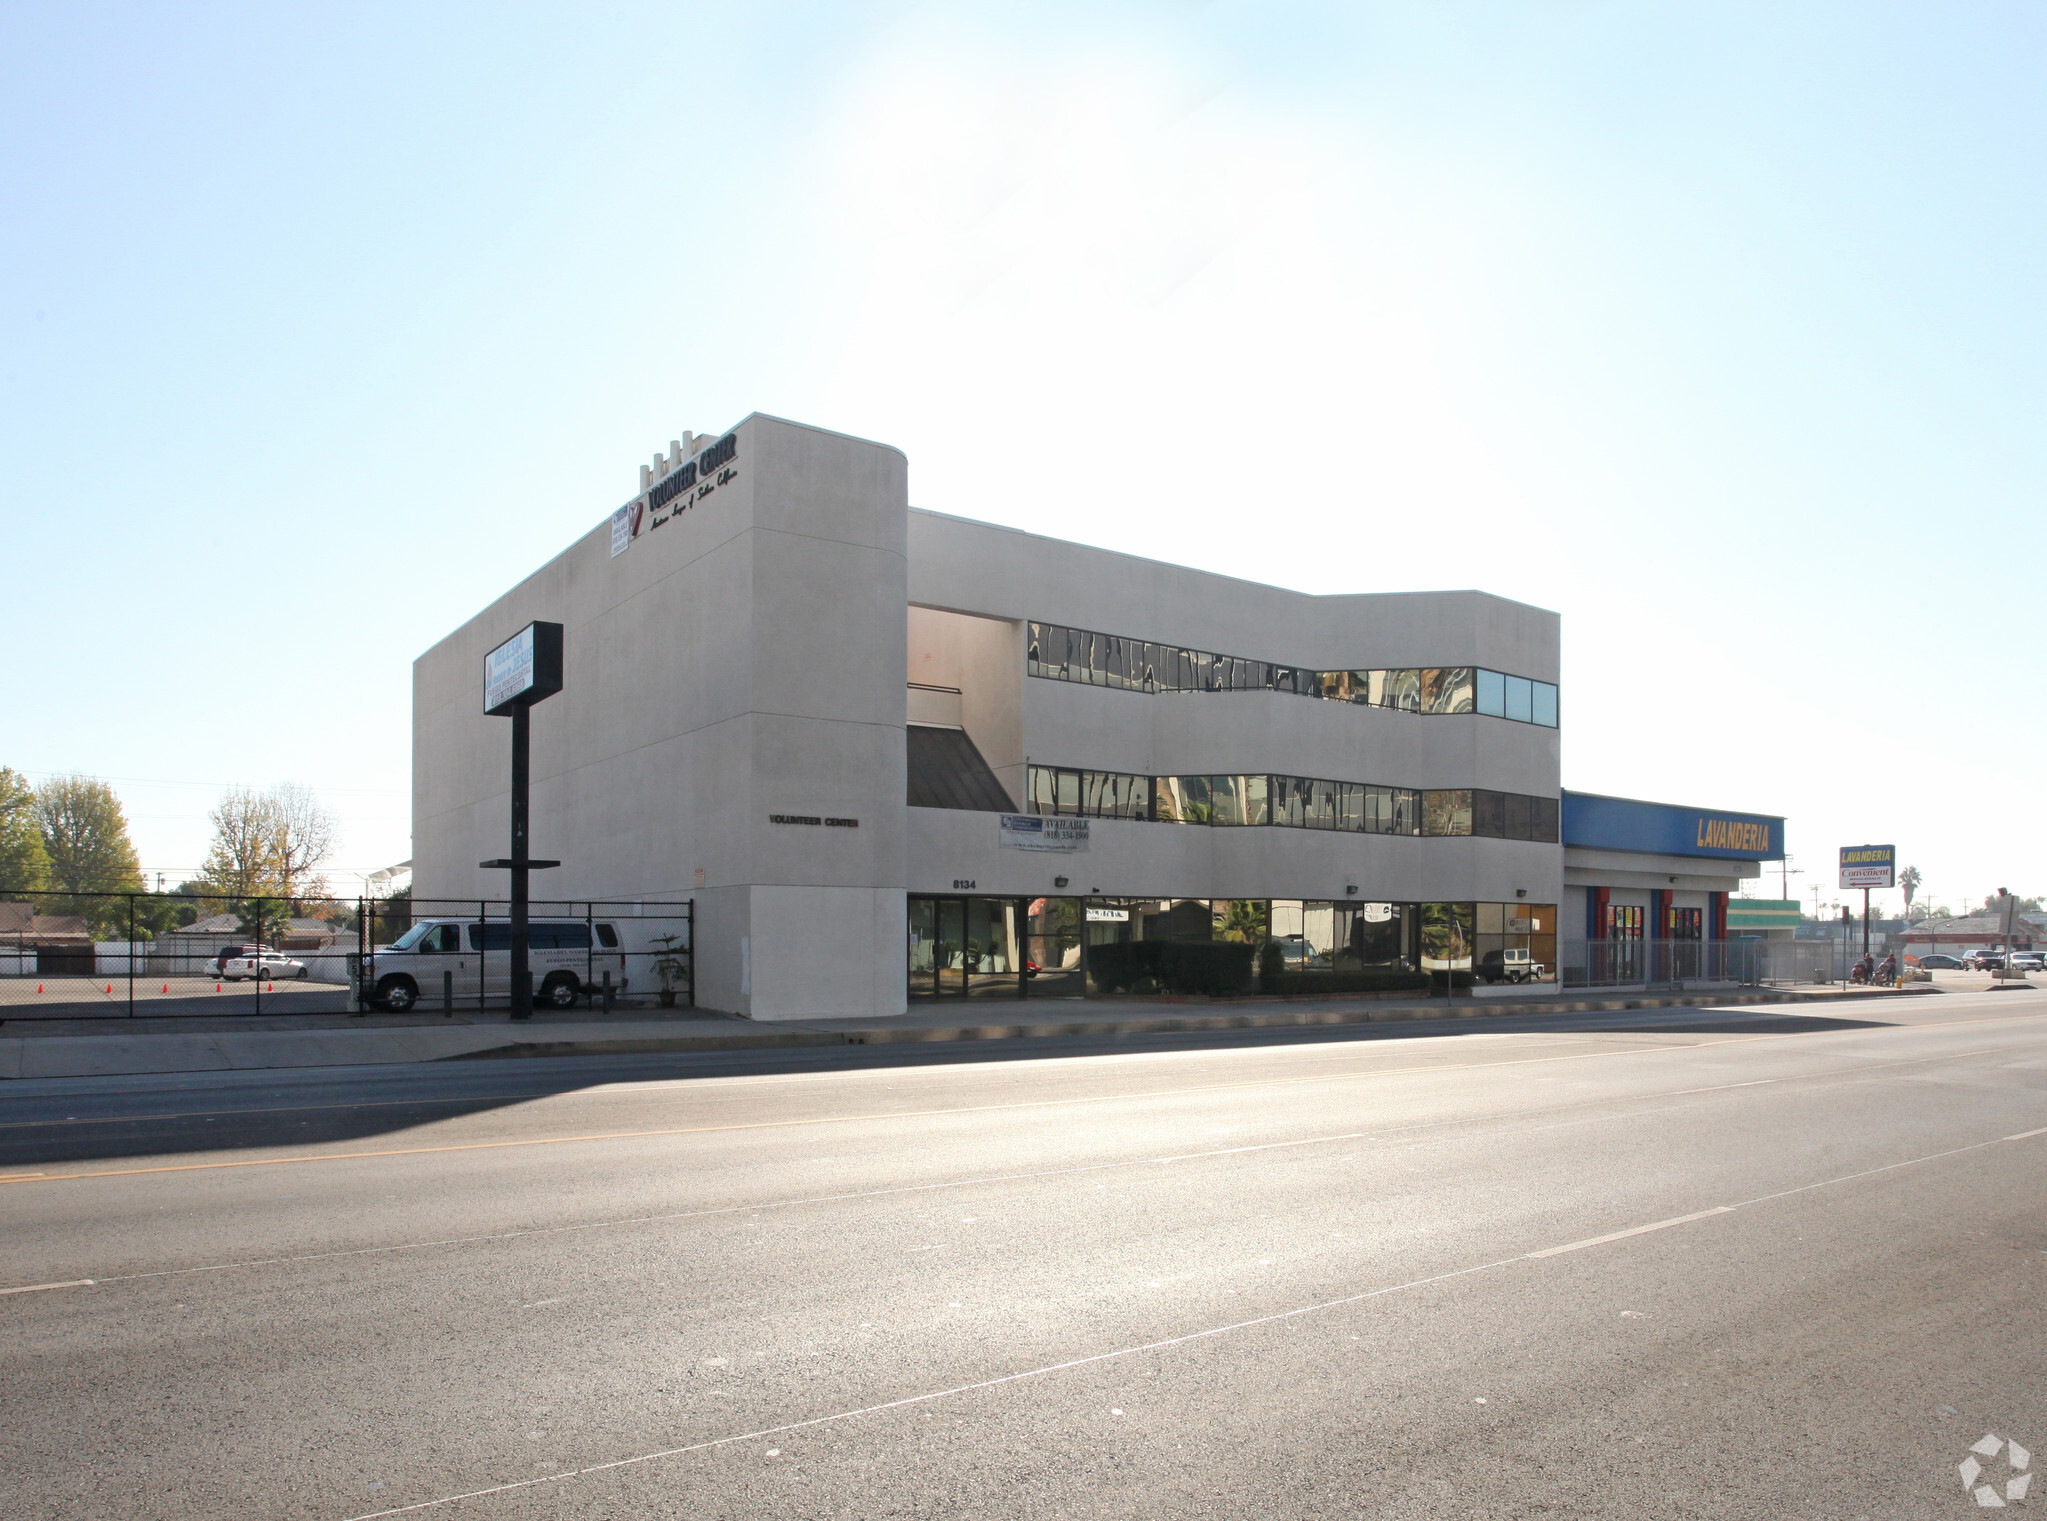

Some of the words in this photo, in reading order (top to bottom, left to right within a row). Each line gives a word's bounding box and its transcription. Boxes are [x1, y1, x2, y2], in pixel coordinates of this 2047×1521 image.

[649, 462, 697, 512] VOLUNTEER
[699, 433, 737, 476] CENTER
[770, 814, 821, 826] VOLUNTEER
[825, 817, 859, 828] CENTER
[1044, 820, 1089, 830] AVAILABLE
[1697, 818, 1769, 852] LAVANDERIA
[1842, 849, 1891, 863] LAVANDERIA
[953, 880, 976, 889] 8134
